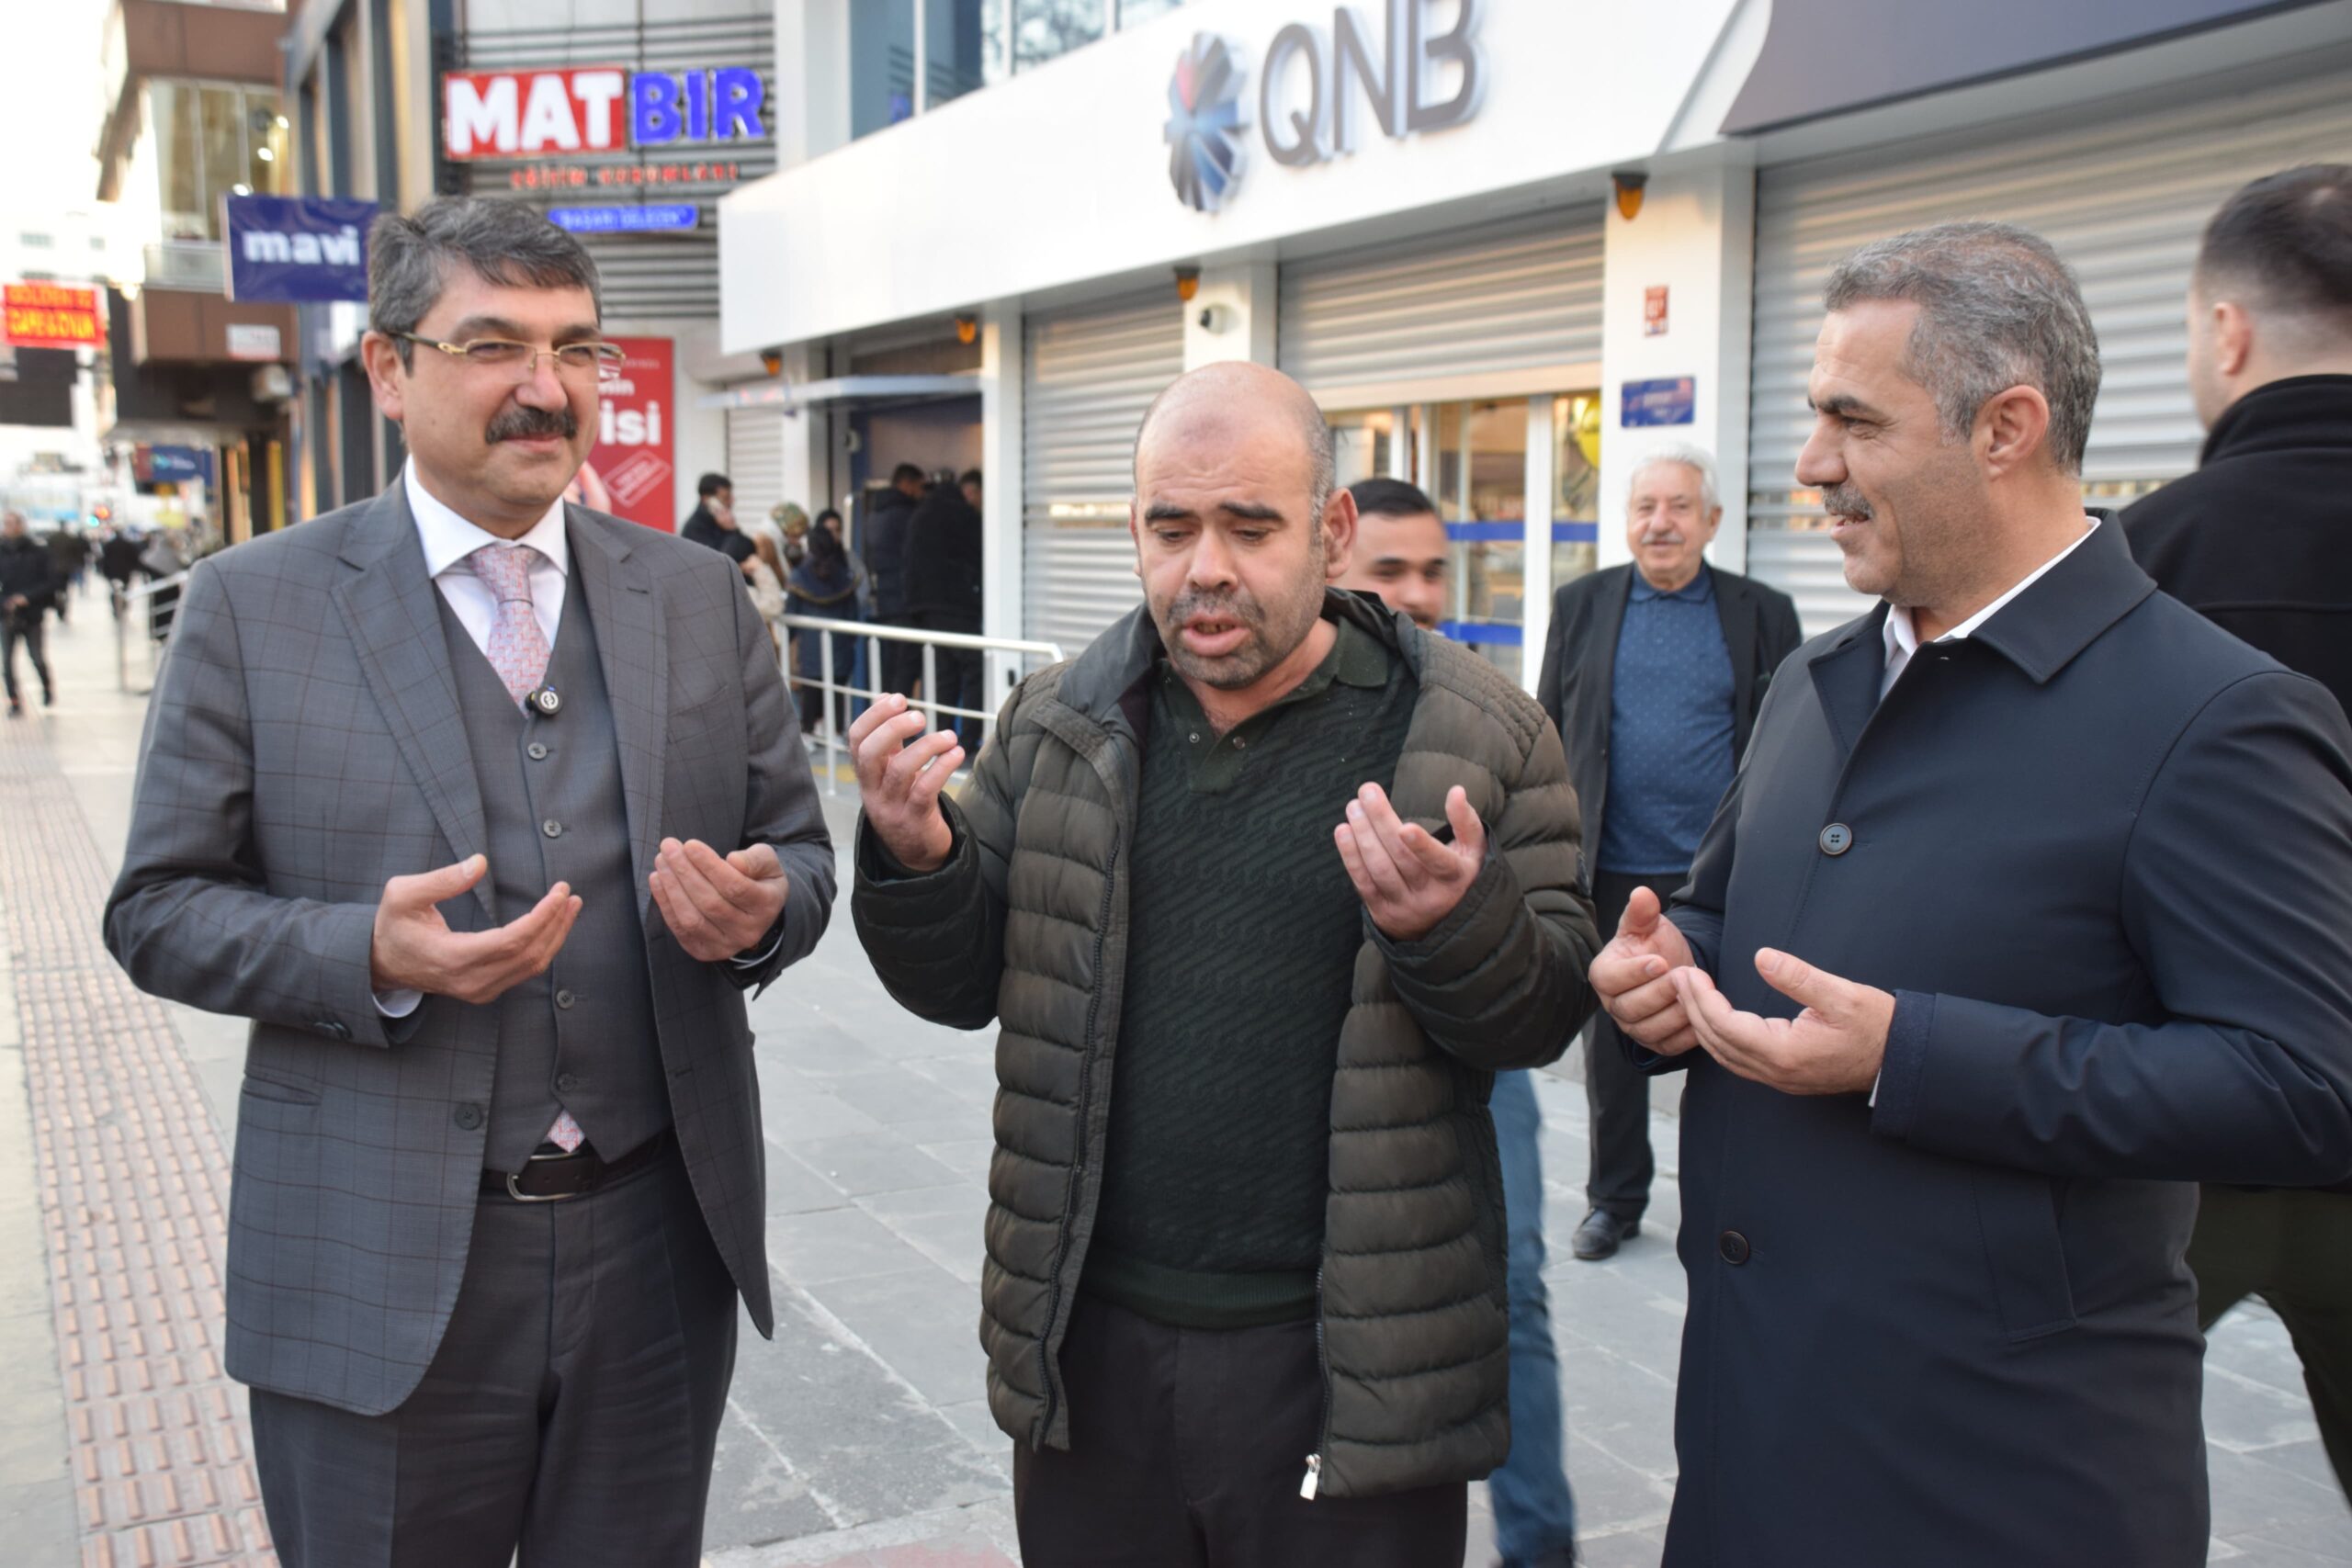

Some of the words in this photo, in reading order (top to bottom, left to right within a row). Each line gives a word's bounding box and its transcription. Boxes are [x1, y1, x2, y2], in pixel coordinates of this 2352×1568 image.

[448, 73, 623, 153] MAT
[1260, 0, 1485, 166] QNB
[243, 226, 359, 265] mavi
